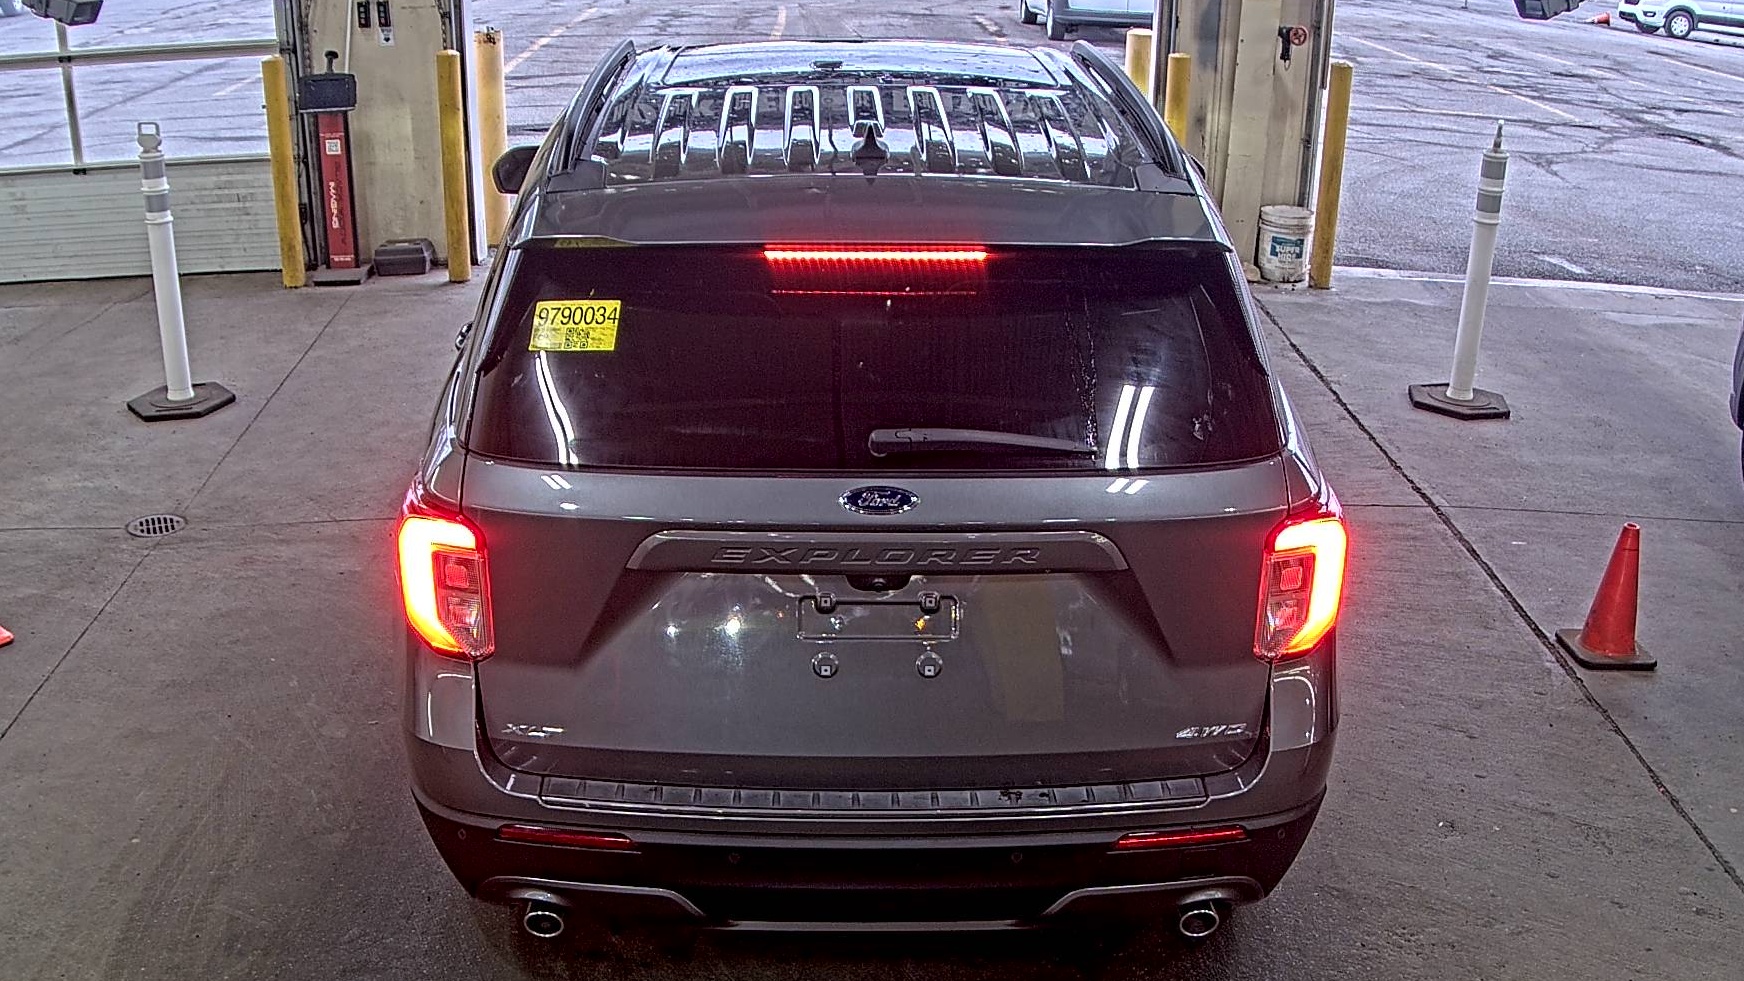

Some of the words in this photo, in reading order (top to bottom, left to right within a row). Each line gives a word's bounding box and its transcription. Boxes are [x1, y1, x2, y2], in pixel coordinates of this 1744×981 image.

[538, 306, 619, 326] 9790034
[858, 490, 902, 507] Ford
[711, 547, 1041, 565] EXPLORER
[501, 723, 565, 738] XLT
[1175, 723, 1247, 739] 4WD
